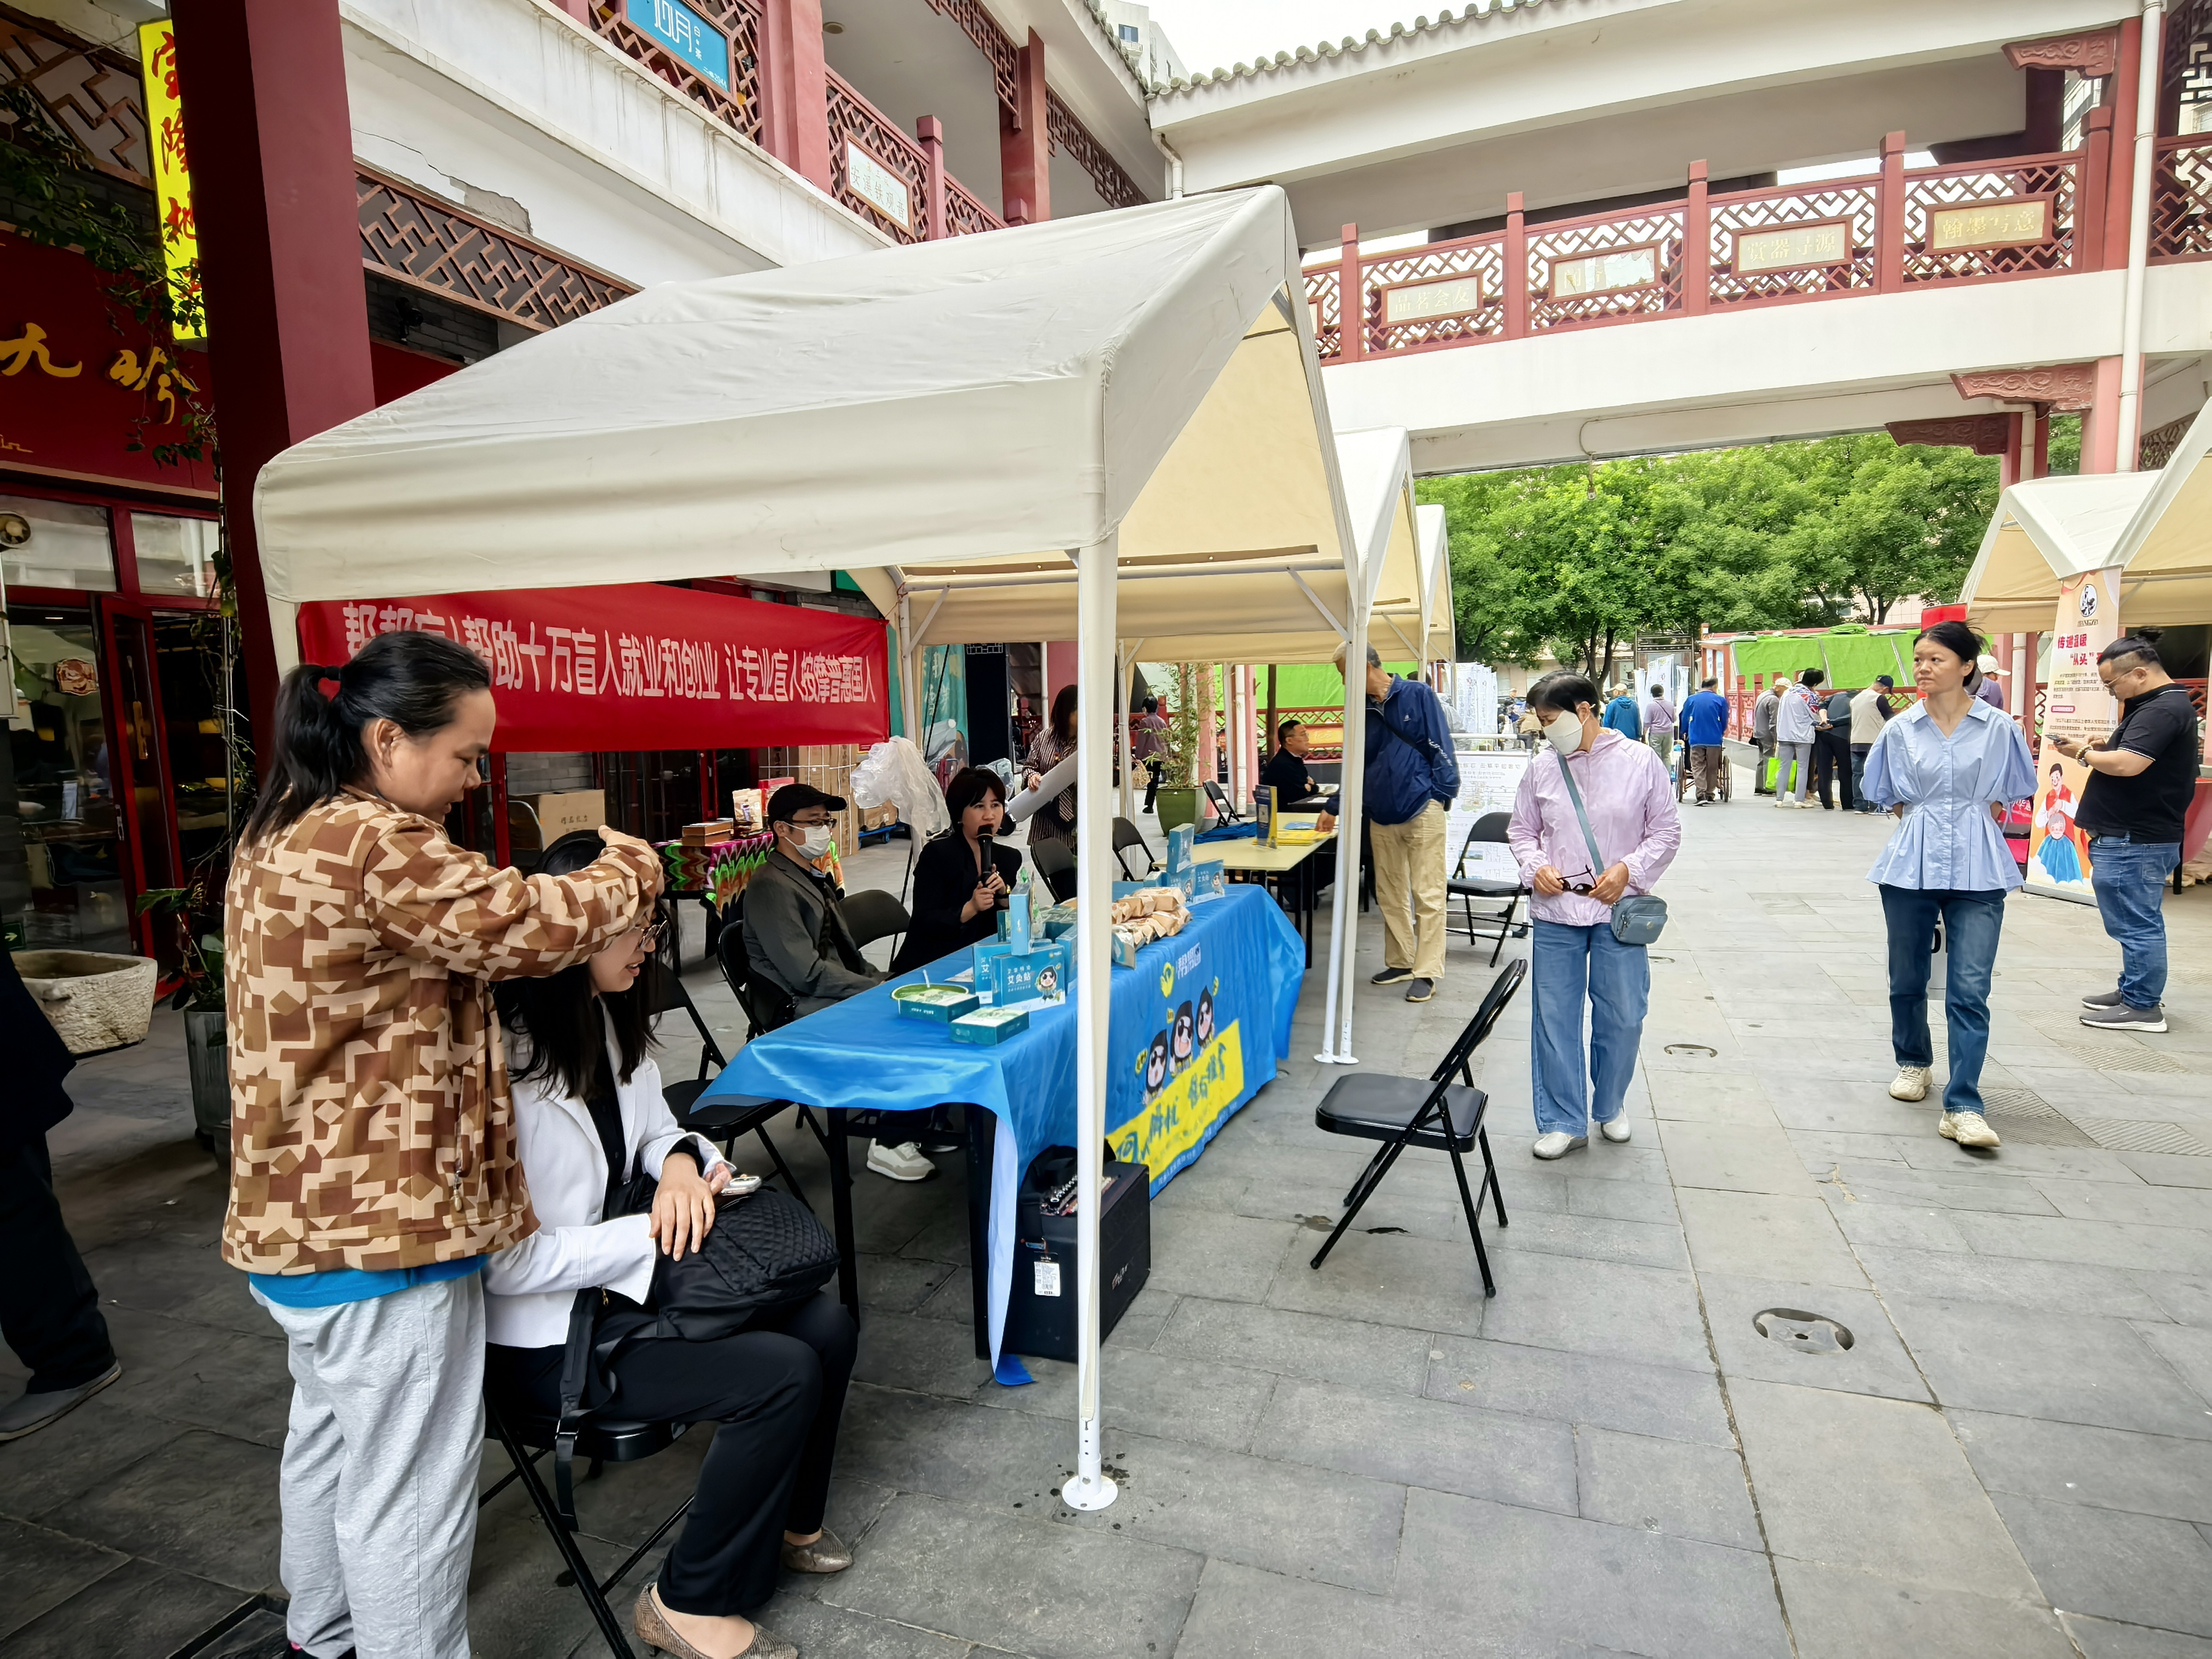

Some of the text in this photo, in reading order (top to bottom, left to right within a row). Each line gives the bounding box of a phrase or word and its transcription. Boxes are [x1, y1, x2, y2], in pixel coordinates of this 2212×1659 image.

[851, 165, 904, 220] 安溪铁观音
[1942, 211, 2035, 240] 翰墨写意
[1747, 231, 1836, 263] 赏器寻源
[1395, 285, 1470, 313] 品茗会友
[342, 601, 721, 700] 帮帮助十万盲人就业和创业
[724, 642, 876, 703] 让专业盲人按摩普惠国人
